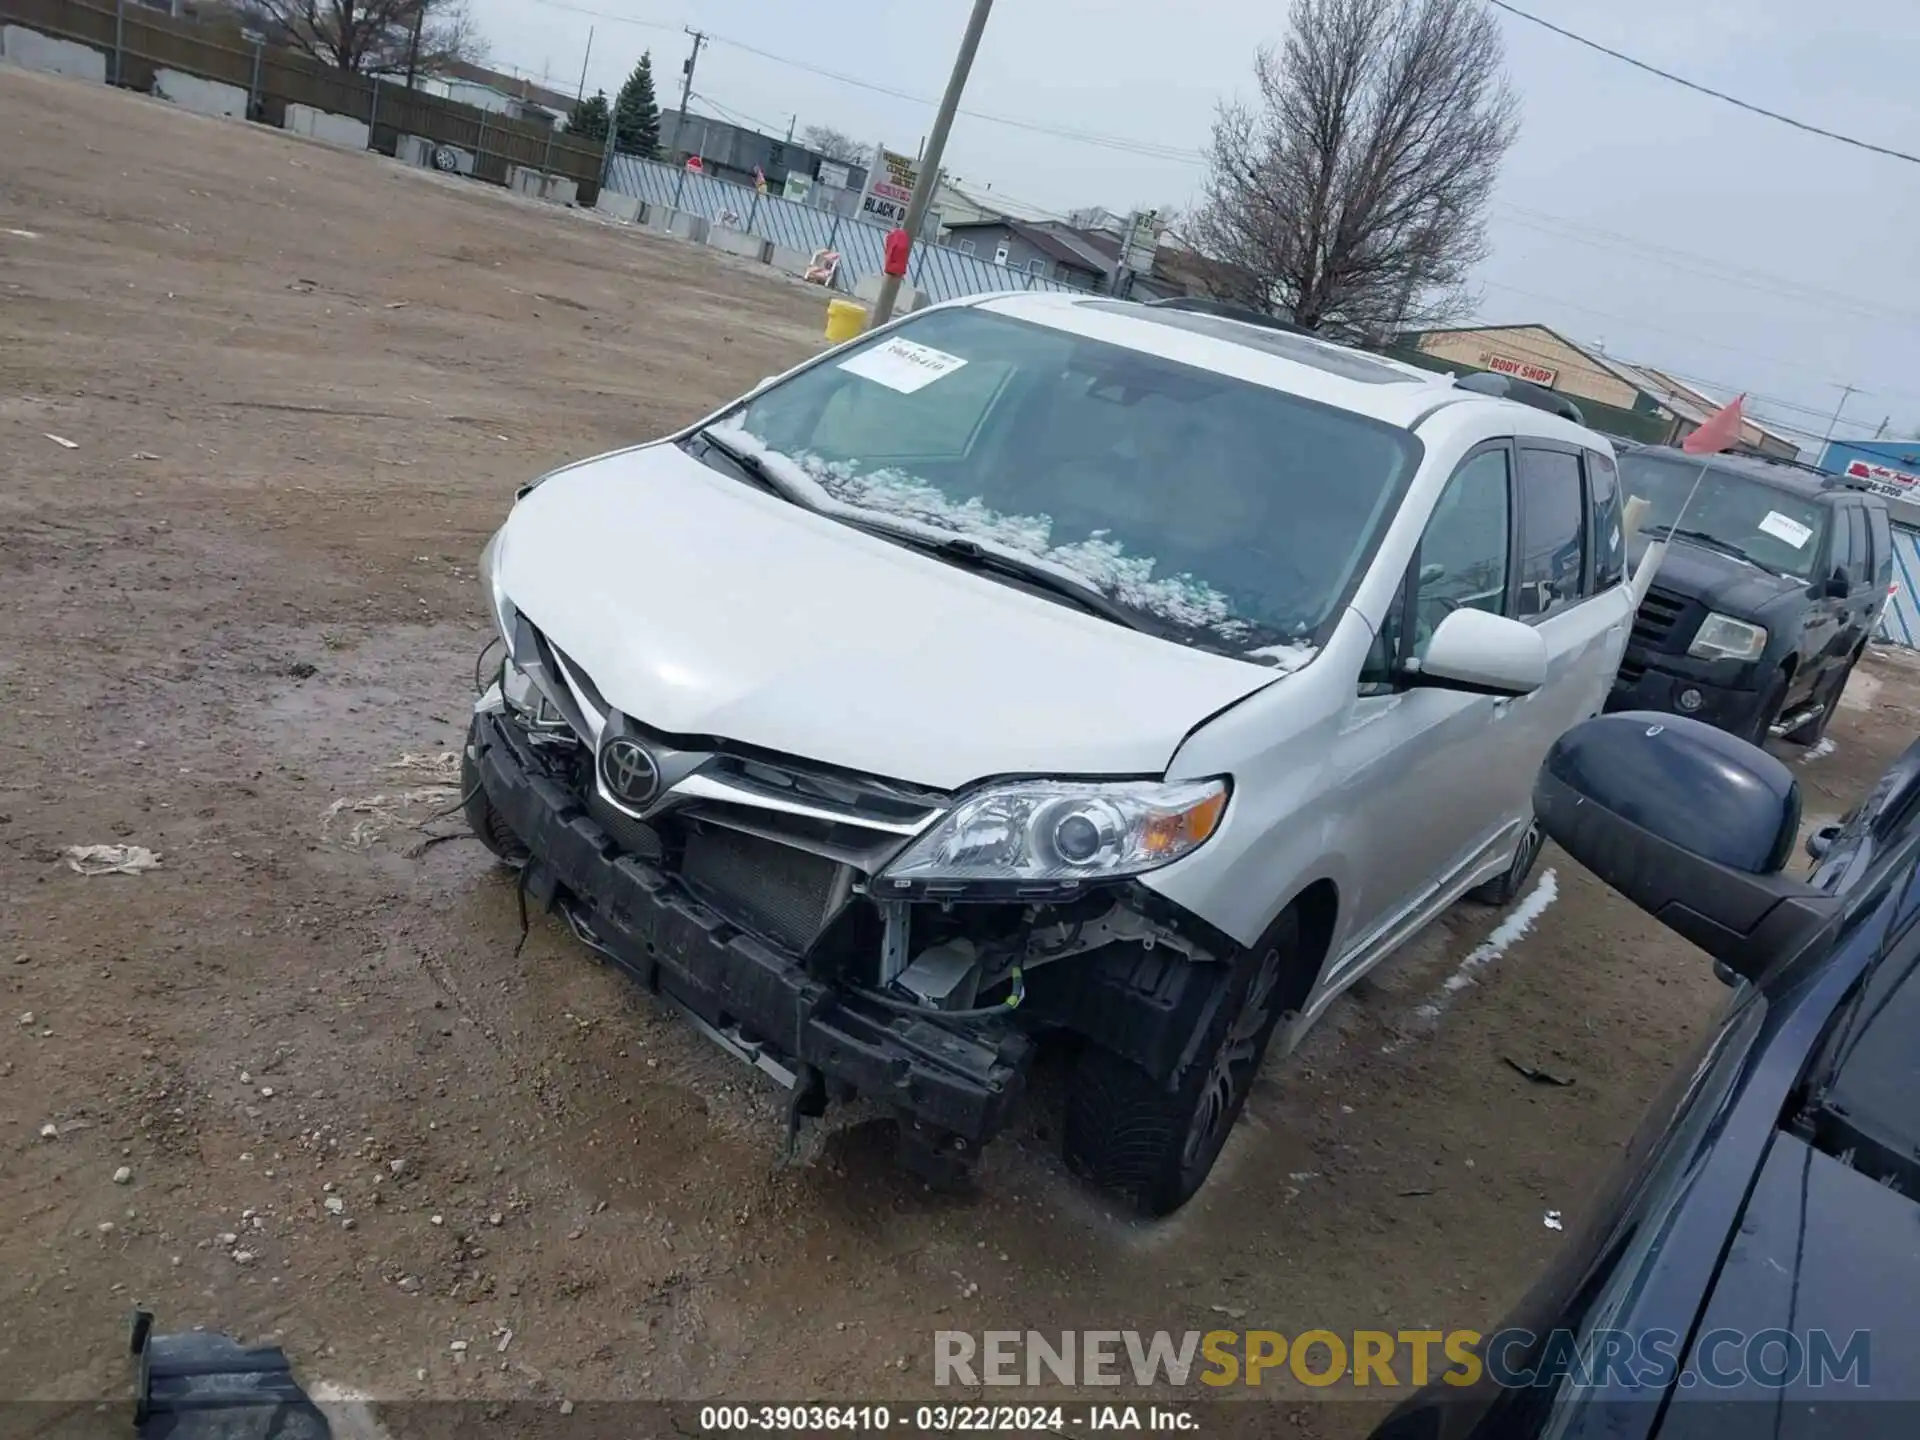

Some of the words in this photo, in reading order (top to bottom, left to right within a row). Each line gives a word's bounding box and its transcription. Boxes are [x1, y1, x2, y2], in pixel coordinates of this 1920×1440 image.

[863, 197, 896, 219] BLACK
[1490, 357, 1520, 374] BODY
[1521, 366, 1552, 382] SHOP
